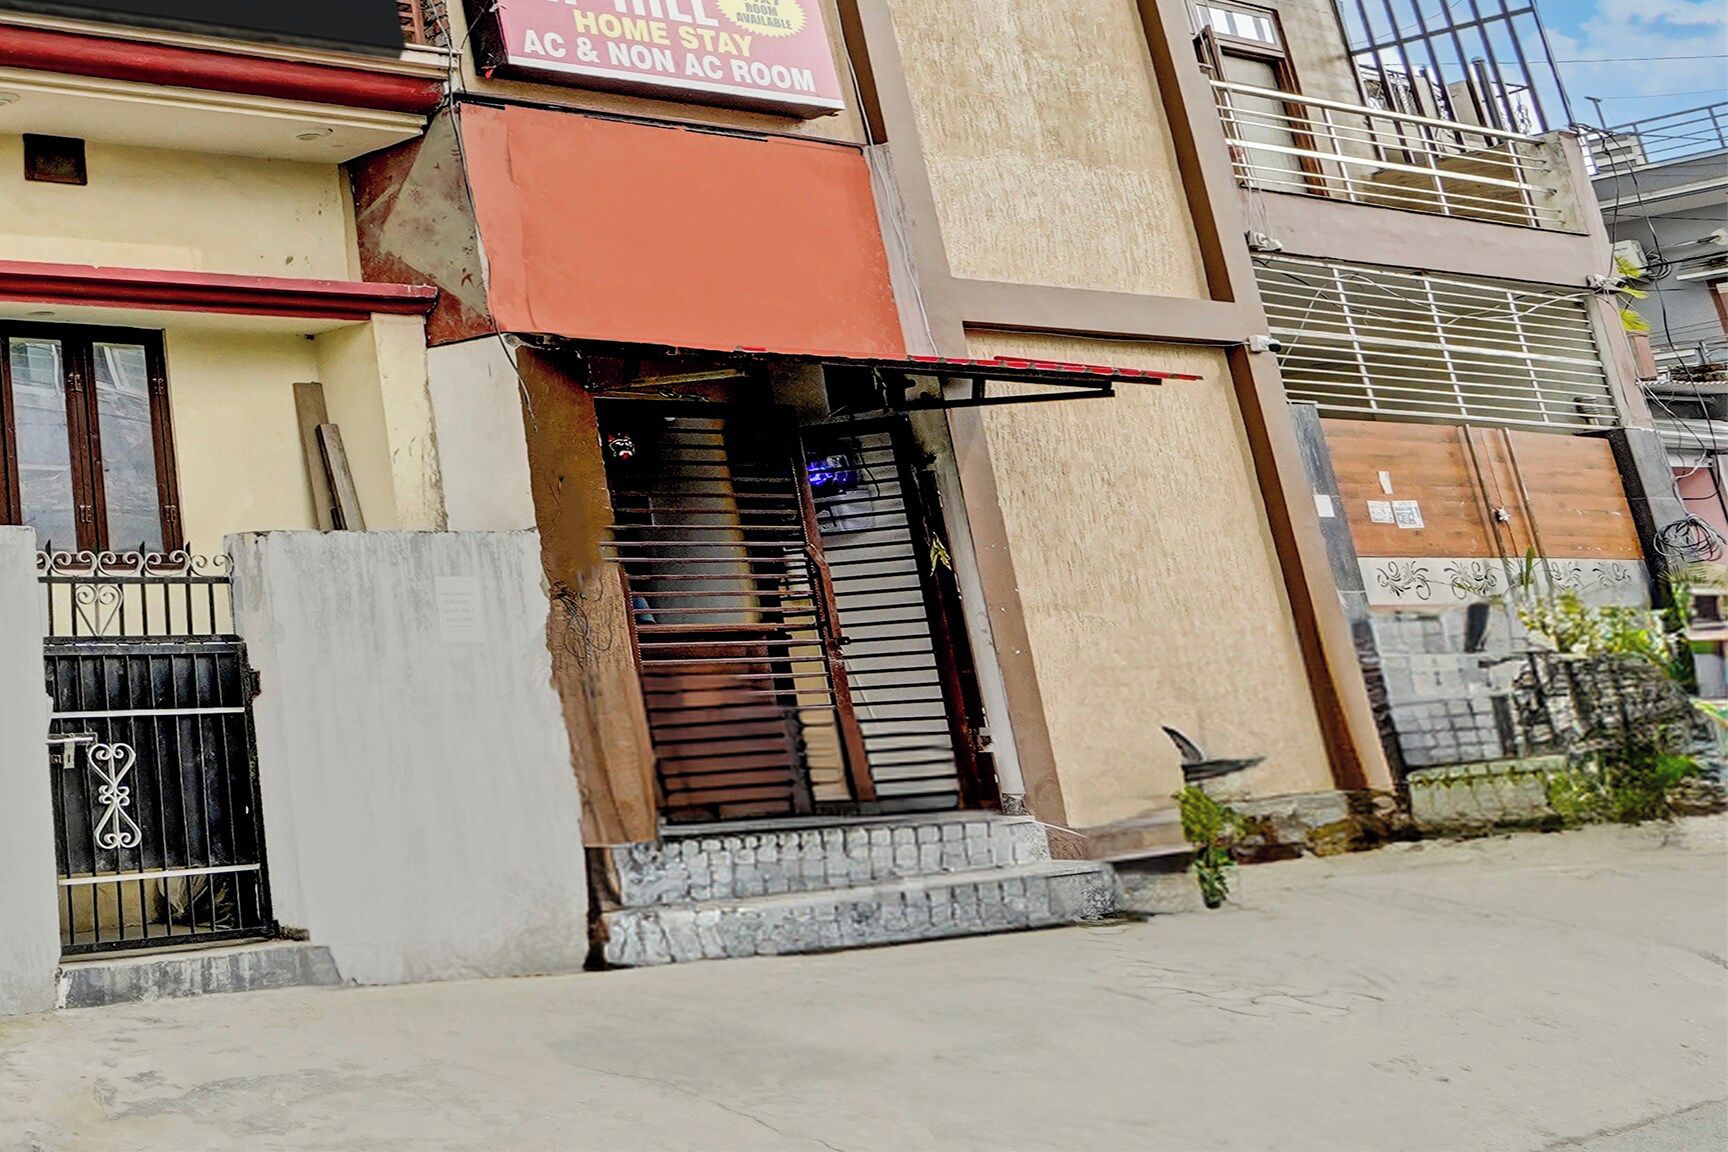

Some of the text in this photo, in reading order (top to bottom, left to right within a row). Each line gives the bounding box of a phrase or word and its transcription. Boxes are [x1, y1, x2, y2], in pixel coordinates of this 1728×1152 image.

[736, 12, 792, 30] AVAILABLE
[745, 2, 778, 17] ROOM
[573, 9, 752, 57] HOME STAY
[523, 29, 817, 92] AC & NON AC ROOM
